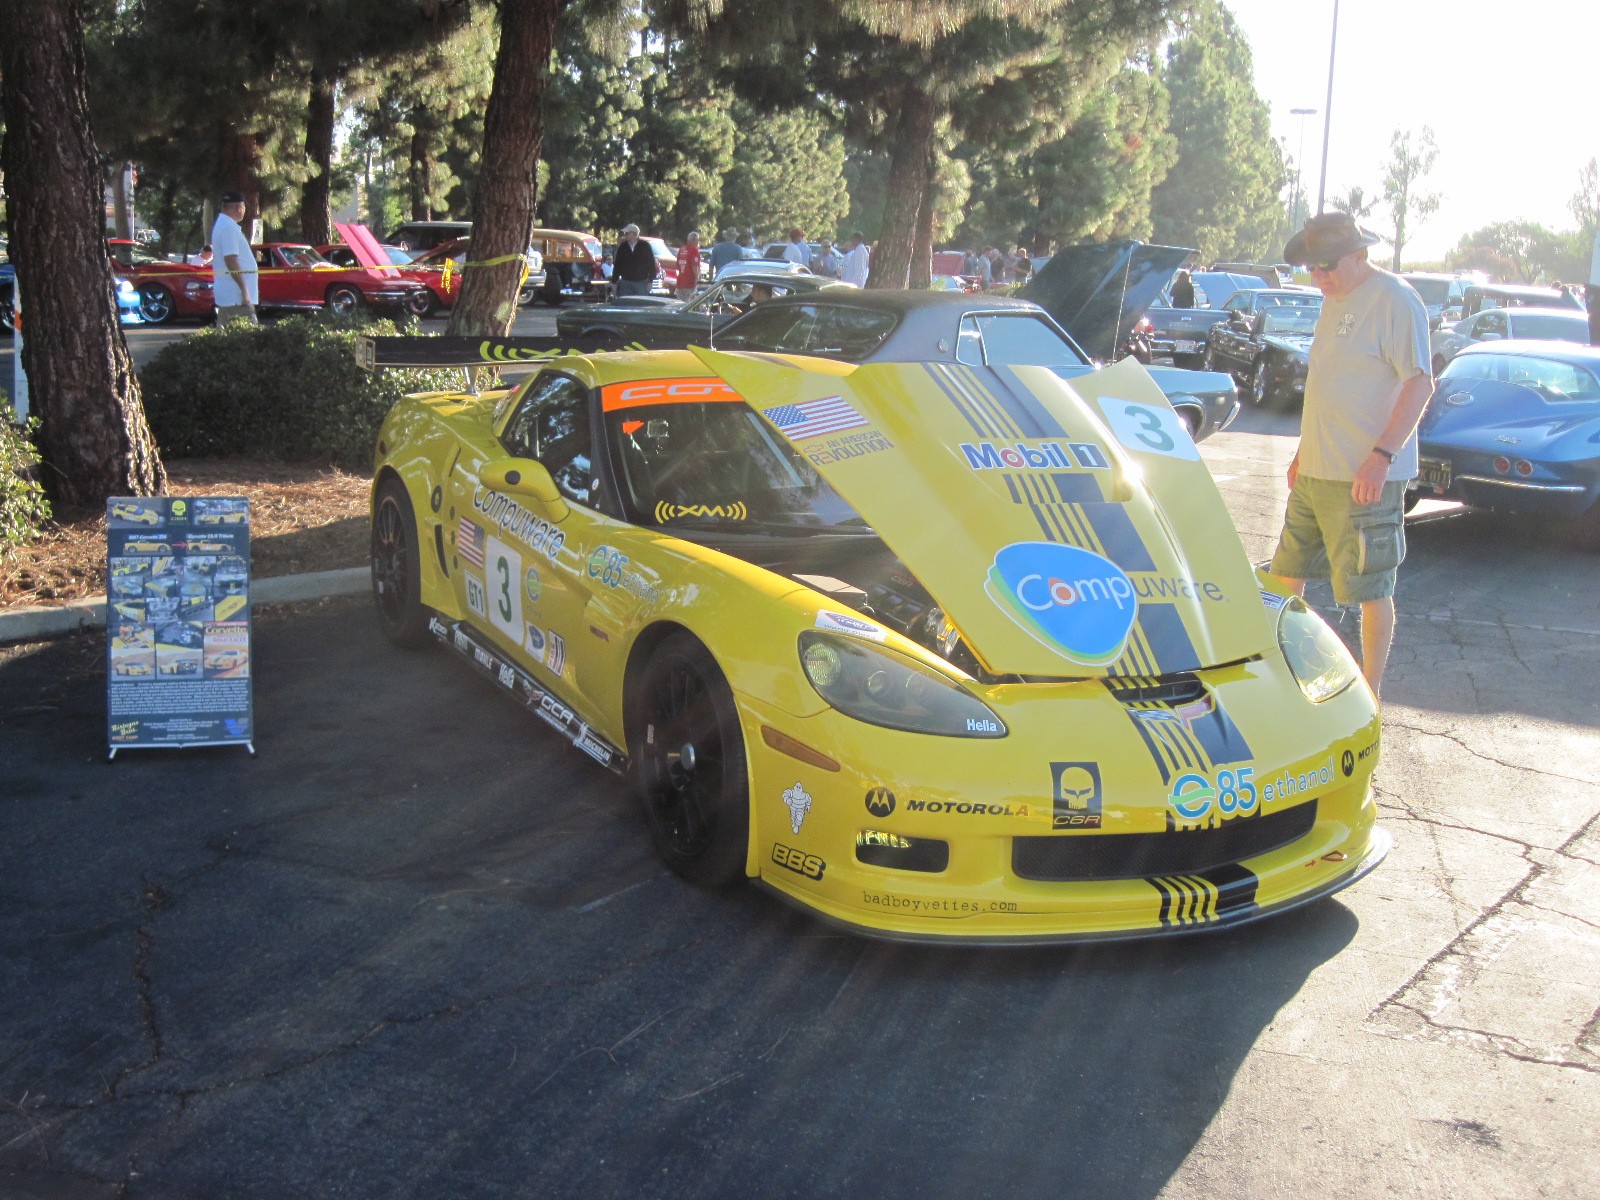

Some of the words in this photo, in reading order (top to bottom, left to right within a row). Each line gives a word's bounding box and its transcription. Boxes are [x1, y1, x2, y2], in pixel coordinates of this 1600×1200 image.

[826, 440, 840, 448] AN
[840, 430, 883, 445] AMERICAN
[1125, 405, 1175, 452] 3
[808, 437, 895, 466] REVOLUTION
[959, 442, 1072, 470] Mobil
[473, 483, 566, 559] Compuware
[468, 579, 484, 614] GT1
[497, 556, 512, 622] 3
[1016, 573, 1224, 611] Compuware
[966, 718, 997, 733] Hella
[583, 738, 611, 761] MICHELIN
[1263, 755, 1335, 802] ethanol
[906, 799, 1029, 817] MOTOROLA
[1053, 815, 1101, 826] C6R
[772, 843, 827, 881] BBS
[863, 891, 1018, 912] badboyvettes.com
